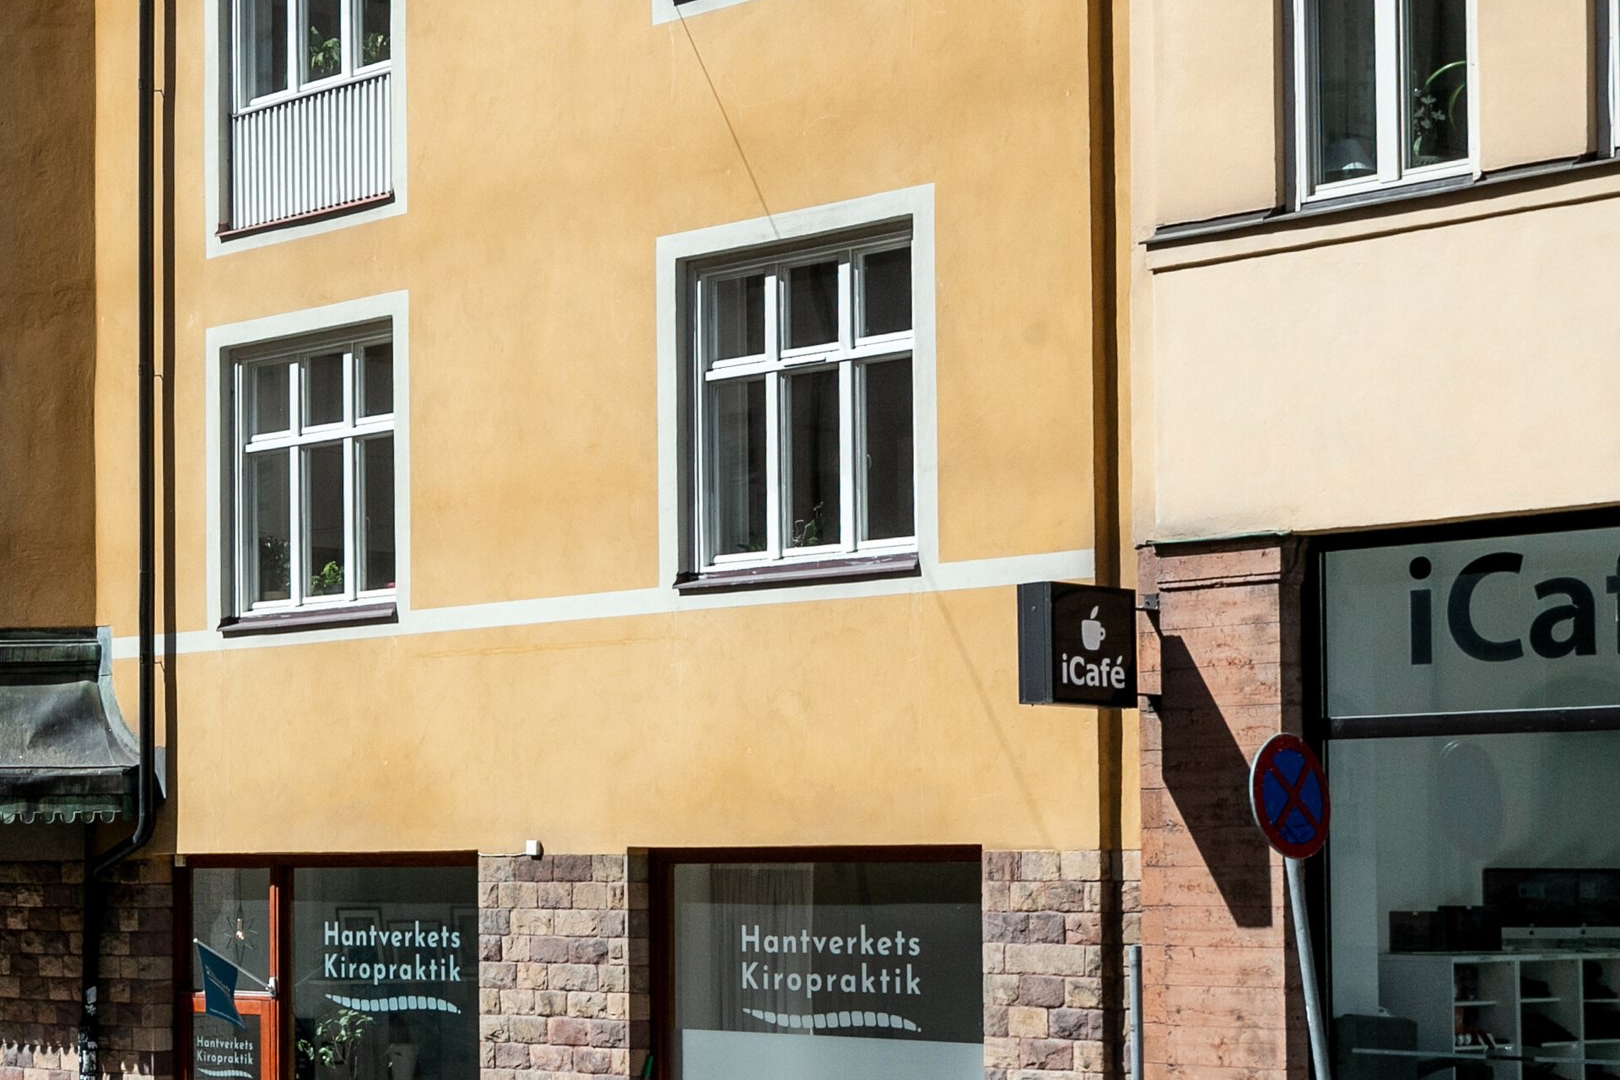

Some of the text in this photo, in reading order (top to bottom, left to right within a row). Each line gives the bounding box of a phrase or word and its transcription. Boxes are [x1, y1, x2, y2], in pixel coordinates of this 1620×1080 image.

[1062, 653, 1125, 689] iCafé
[324, 920, 461, 948] Hantverkets
[741, 924, 921, 956] Hantverkets
[324, 953, 461, 985] Kiropraktik
[741, 961, 921, 999] Kiropraktik
[196, 1037, 253, 1050] Hantverkets
[196, 1051, 253, 1065] Kiropraktik
